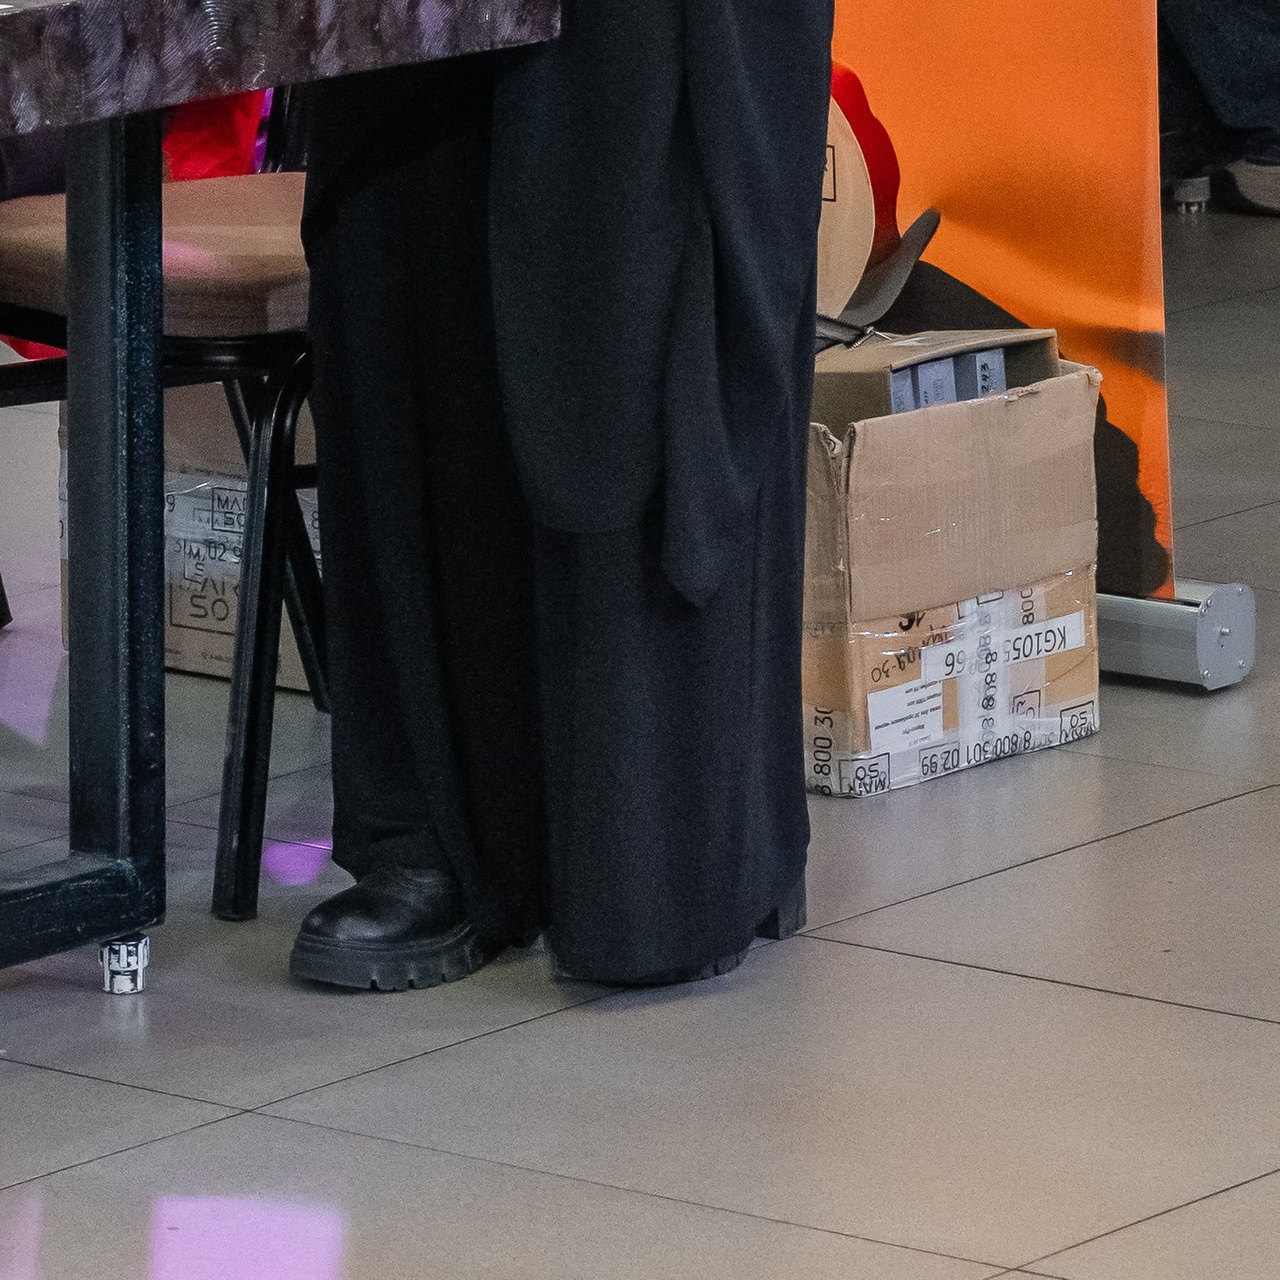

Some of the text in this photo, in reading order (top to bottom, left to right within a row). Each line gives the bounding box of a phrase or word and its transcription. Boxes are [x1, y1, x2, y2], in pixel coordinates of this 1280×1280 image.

[189, 594, 230, 622] SO
[1070, 710, 1088, 728] SO
[1023, 731, 1032, 750] 8
[813, 736, 832, 776] 800
[943, 748, 960, 770] 02
[966, 740, 992, 765] 301
[855, 762, 880, 781] SO
[921, 753, 938, 776] 99
